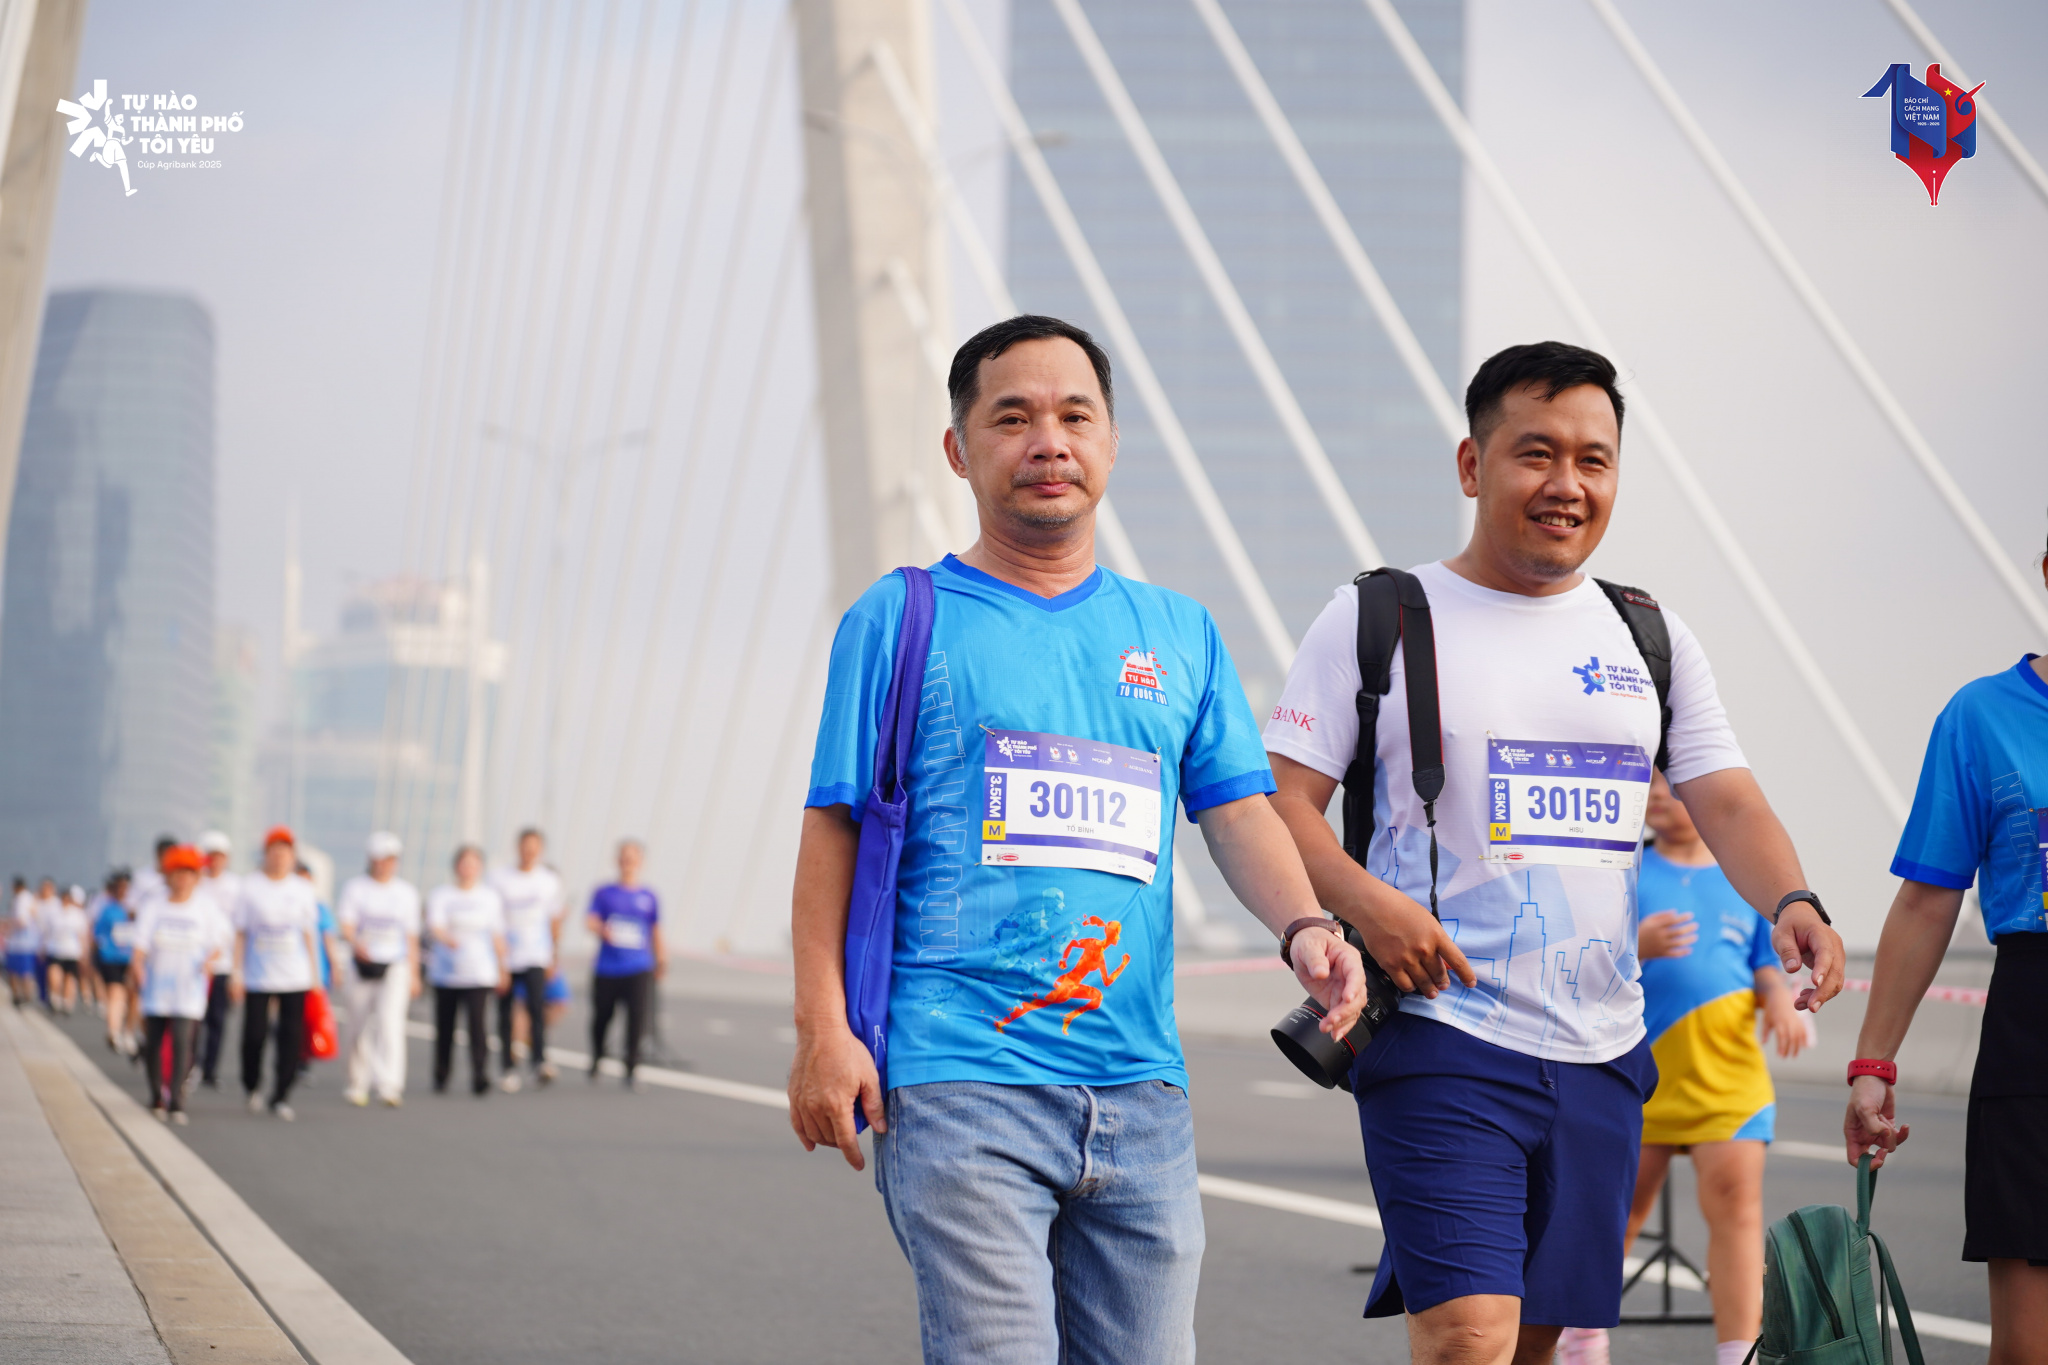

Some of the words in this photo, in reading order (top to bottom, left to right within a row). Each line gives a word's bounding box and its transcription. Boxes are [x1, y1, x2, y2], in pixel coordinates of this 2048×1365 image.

[1606, 665, 1618, 673] TỰ
[1620, 666, 1639, 675] HÀO
[1608, 673, 1638, 683] THÀNH
[1610, 682, 1625, 690] TÔI
[1627, 684, 1643, 693] YÊU
[989, 775, 1002, 818] 3.5KM
[1030, 780, 1127, 828] 30112
[1494, 781, 1506, 820] 3.5KM
[1528, 786, 1620, 824] 30159
[926, 780, 968, 856] LAO
[988, 825, 1000, 836] M
[1496, 827, 1506, 837] M
